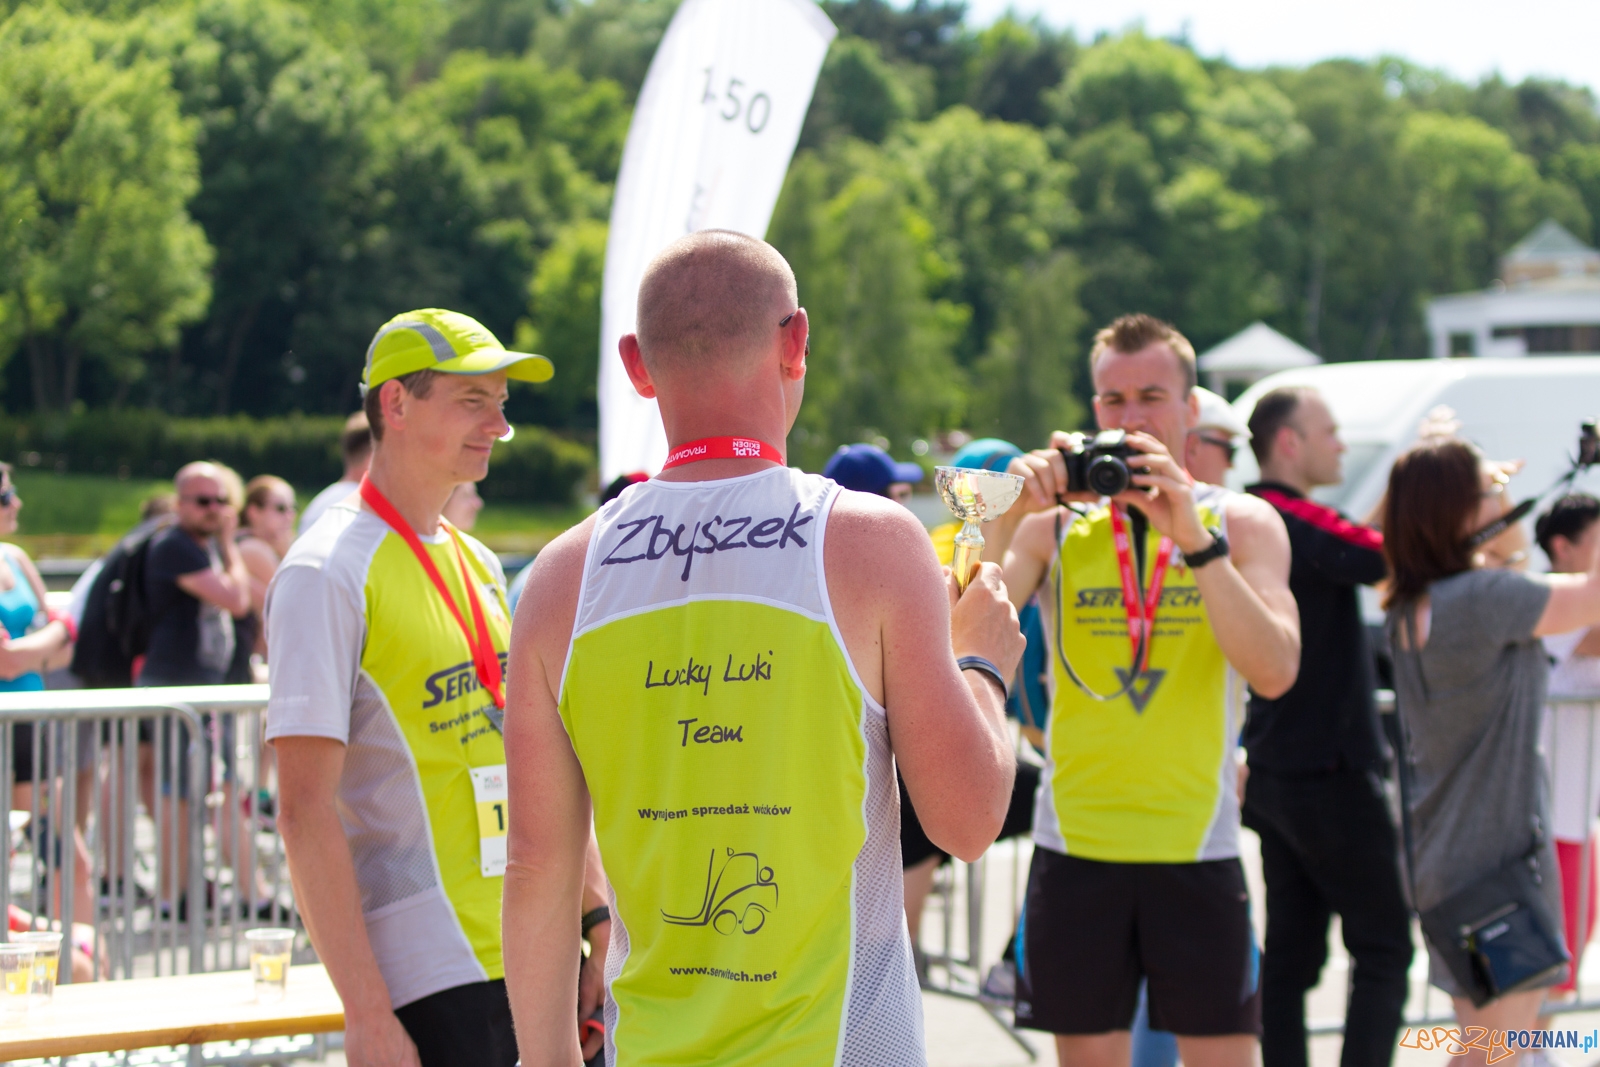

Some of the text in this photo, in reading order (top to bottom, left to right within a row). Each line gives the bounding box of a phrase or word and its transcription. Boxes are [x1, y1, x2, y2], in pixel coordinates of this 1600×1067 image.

[732, 440, 761, 450] EKIDEN
[732, 447, 761, 457] XLPL
[600, 502, 814, 582] Zbyszek
[645, 650, 774, 696] Lucky Luki
[677, 717, 744, 747] Team
[493, 803, 505, 831] 1
[638, 807, 688, 822] Wynajem
[691, 803, 750, 818] sprzedaż
[669, 966, 778, 983] www.serwitech.net
